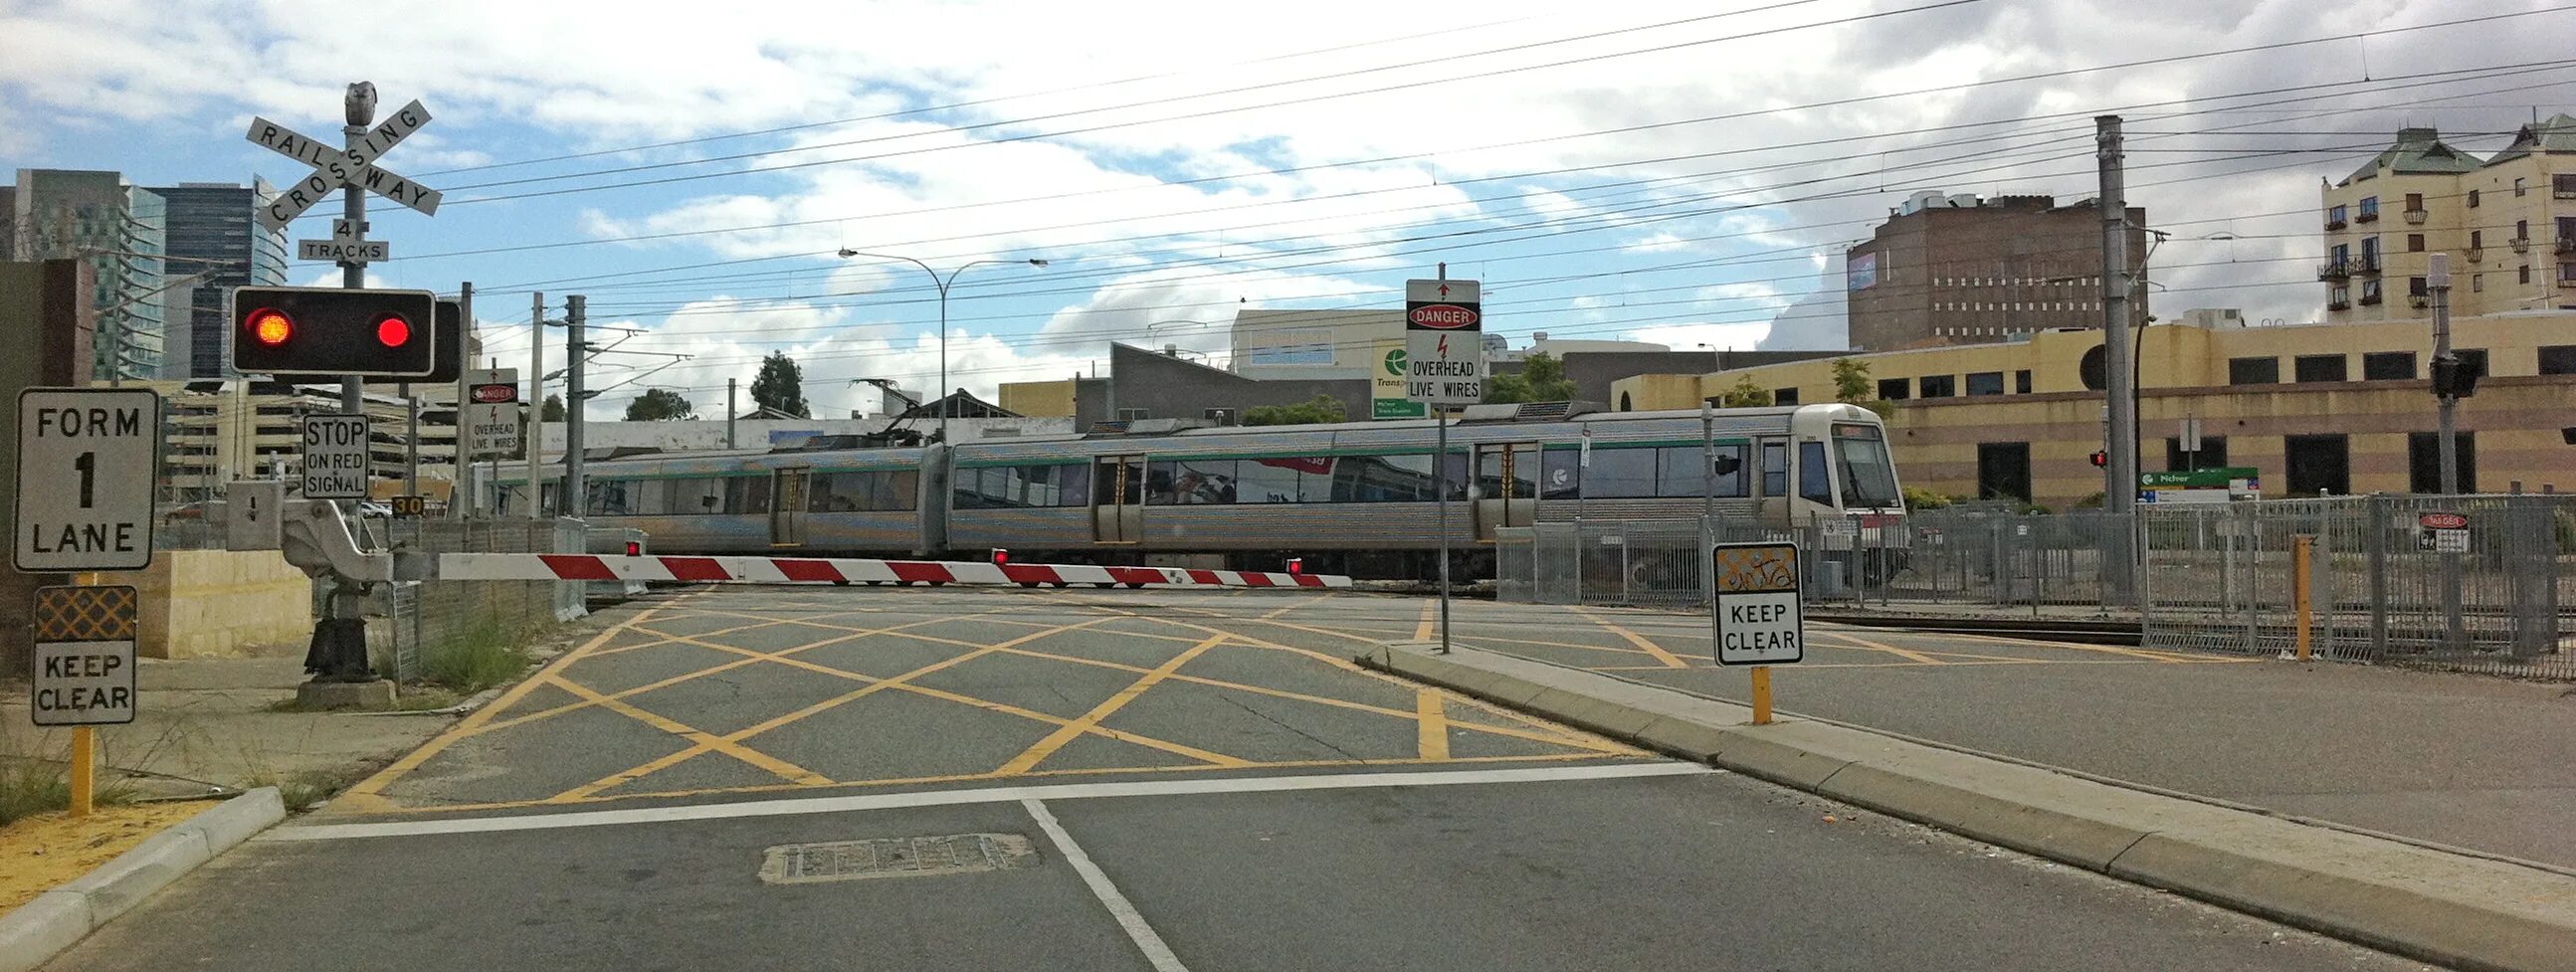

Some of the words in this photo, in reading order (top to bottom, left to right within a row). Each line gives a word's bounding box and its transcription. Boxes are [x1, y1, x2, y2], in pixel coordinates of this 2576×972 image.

[271, 110, 418, 222] CROSSING
[335, 222, 352, 238] 4
[306, 244, 381, 258] TRACKS
[1416, 309, 1470, 323] DANGER
[1413, 361, 1475, 377] OVERHEAD
[476, 388, 511, 398] ANGER
[1410, 382, 1434, 397] LIVE
[1444, 382, 1479, 397] WIRES
[37, 408, 139, 437] FORM
[474, 424, 514, 436] OVERHEAD
[307, 422, 364, 446] STOP
[472, 439, 489, 449] LIVE
[494, 438, 516, 448] WIRES
[308, 454, 328, 469] ON
[333, 454, 363, 469] RED
[75, 452, 95, 508] 1
[308, 477, 363, 492] SIGNAL
[396, 498, 422, 513] 30
[33, 523, 134, 553] LANE
[1731, 604, 1786, 624] KEEP
[1725, 631, 1796, 651] CLEAR
[46, 655, 121, 678] KEEP
[38, 686, 128, 711] CLEAR
